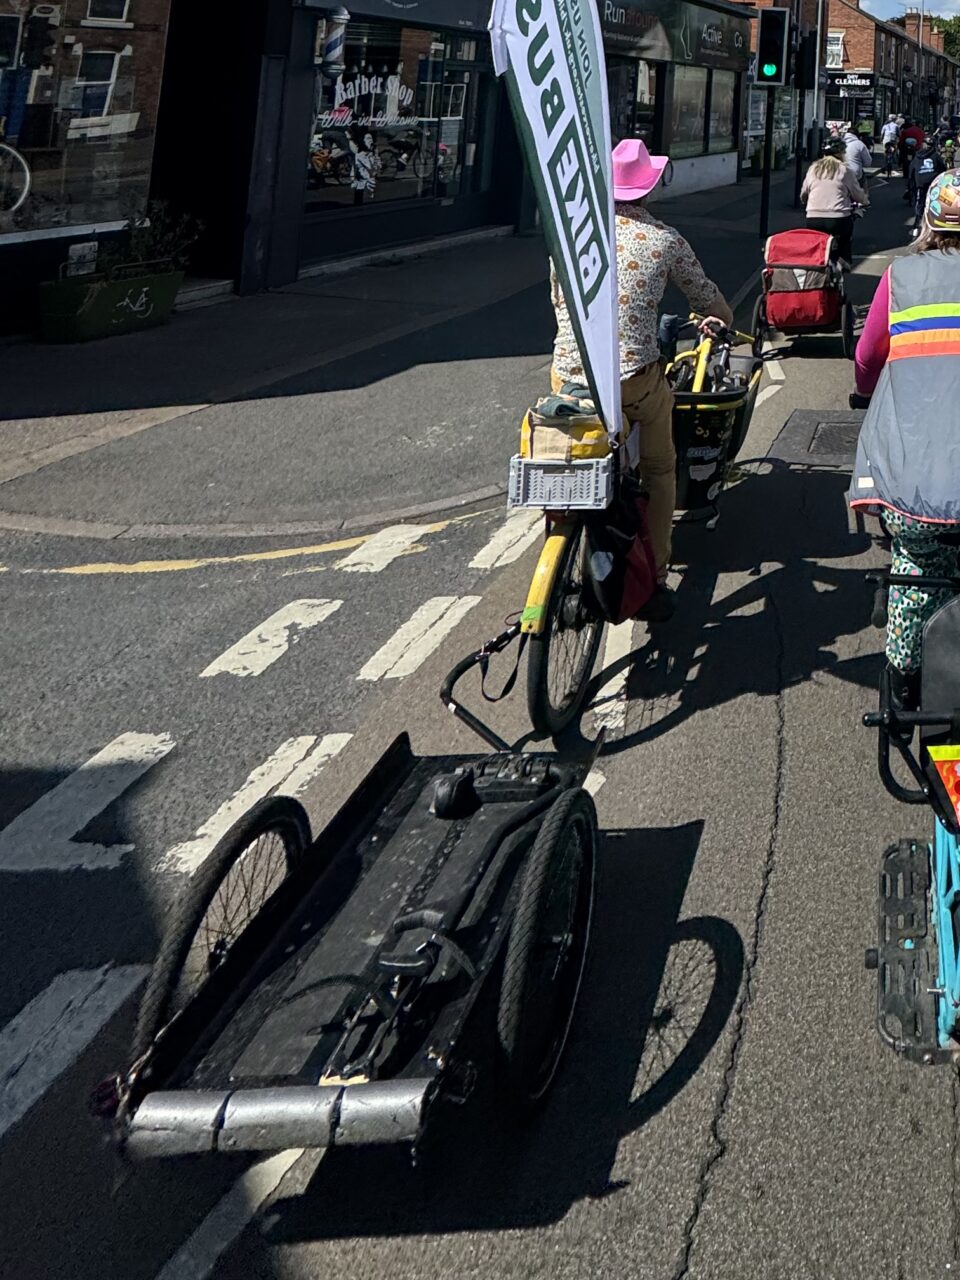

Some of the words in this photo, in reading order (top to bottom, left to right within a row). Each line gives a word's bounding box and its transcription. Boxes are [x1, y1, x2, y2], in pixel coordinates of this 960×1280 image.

[701, 23, 723, 45] Active
[335, 73, 384, 107] Barber
[385, 74, 414, 105] Shop
[835, 78, 871, 86] CLEANERS
